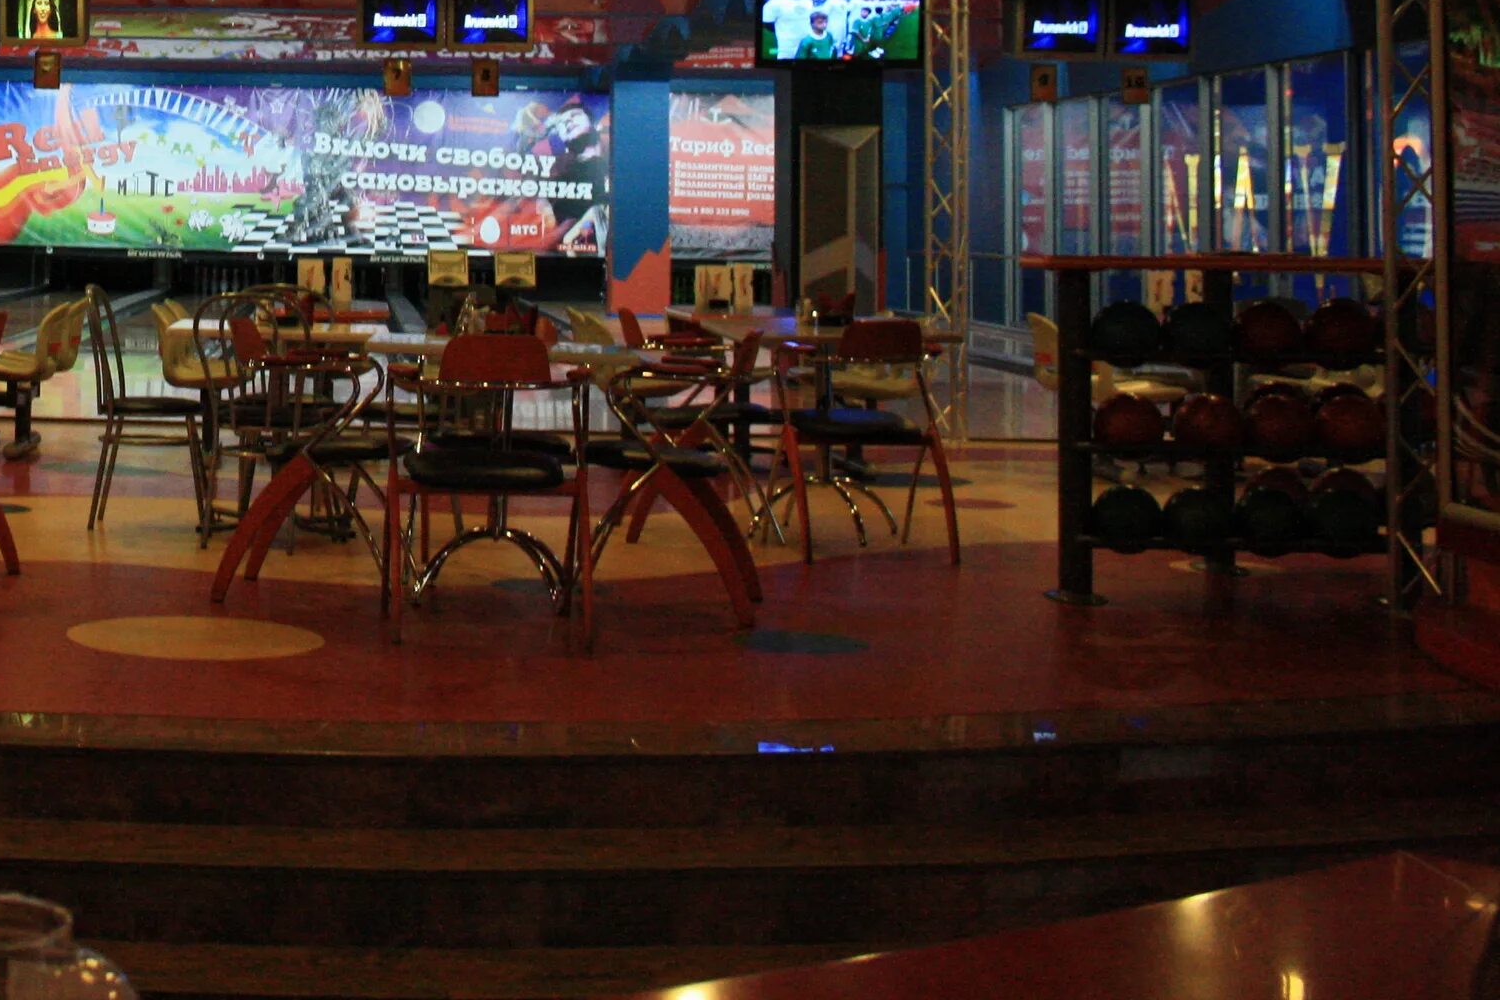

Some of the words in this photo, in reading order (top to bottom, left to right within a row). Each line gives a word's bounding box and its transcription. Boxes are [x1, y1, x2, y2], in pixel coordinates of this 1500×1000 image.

[314, 132, 427, 163] Включи
[435, 147, 556, 178] свободу
[669, 136, 735, 157] Тариф
[341, 172, 593, 200] самовыражения
[510, 224, 538, 236] МТС
